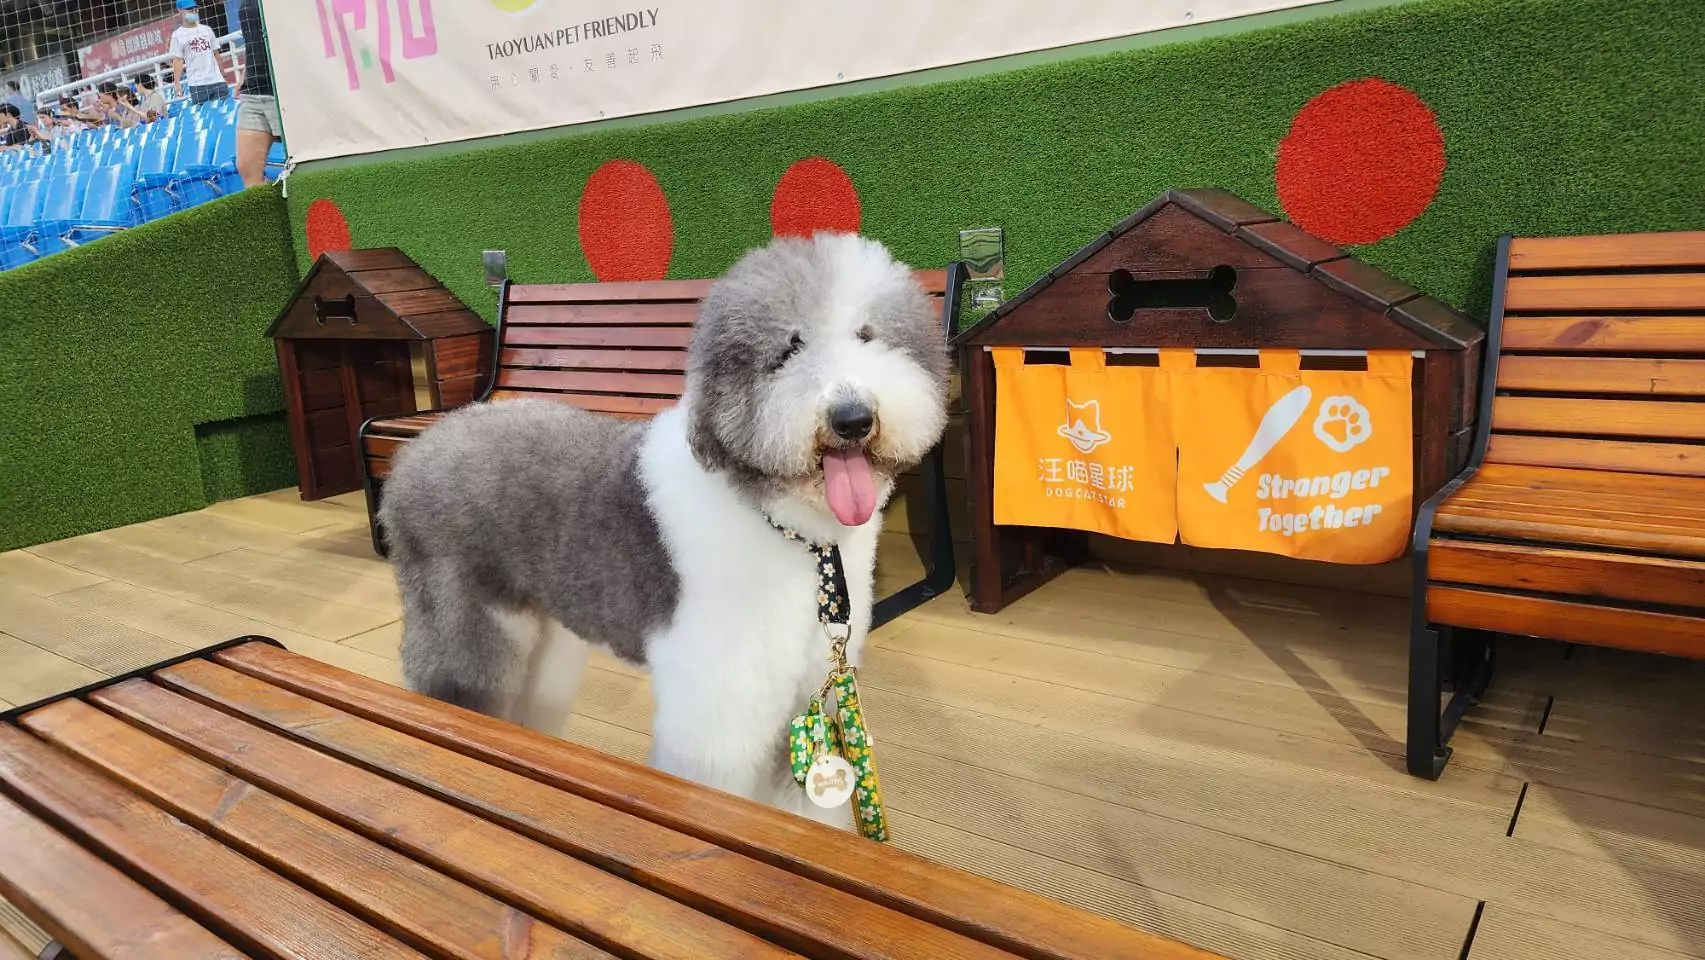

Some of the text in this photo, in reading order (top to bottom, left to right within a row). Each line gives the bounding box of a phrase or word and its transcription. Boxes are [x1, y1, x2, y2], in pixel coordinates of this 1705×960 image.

[485, 7, 659, 61] TAOYUAN PET FRIENDLY
[1038, 457, 1135, 492] 汪喵星球
[1256, 466, 1390, 499] Stronger
[1257, 503, 1383, 537] Together
